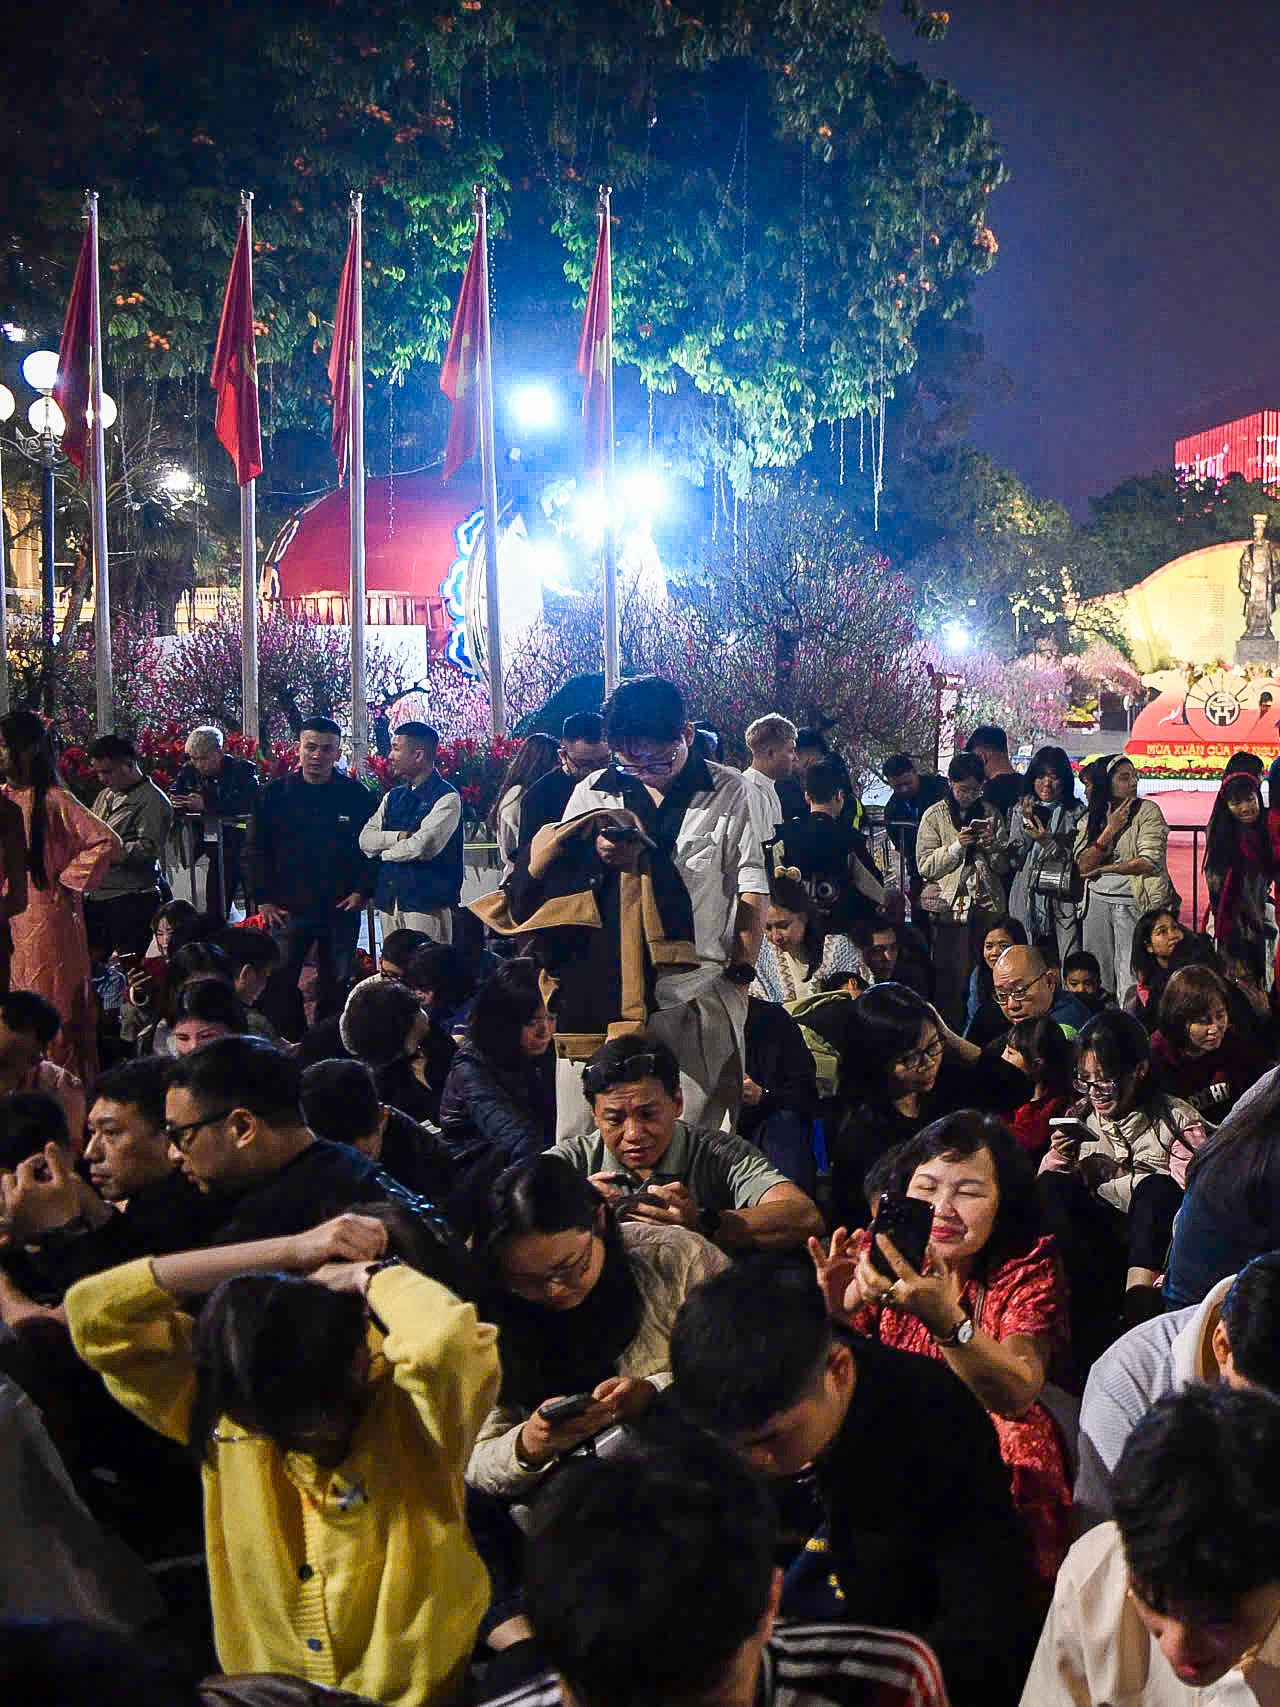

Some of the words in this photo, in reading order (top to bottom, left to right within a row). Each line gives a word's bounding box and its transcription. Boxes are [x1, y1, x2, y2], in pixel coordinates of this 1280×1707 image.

[1146, 743, 1171, 755] MÙA
[1173, 743, 1205, 756] XUÂN
[1207, 743, 1231, 756] CỦA
